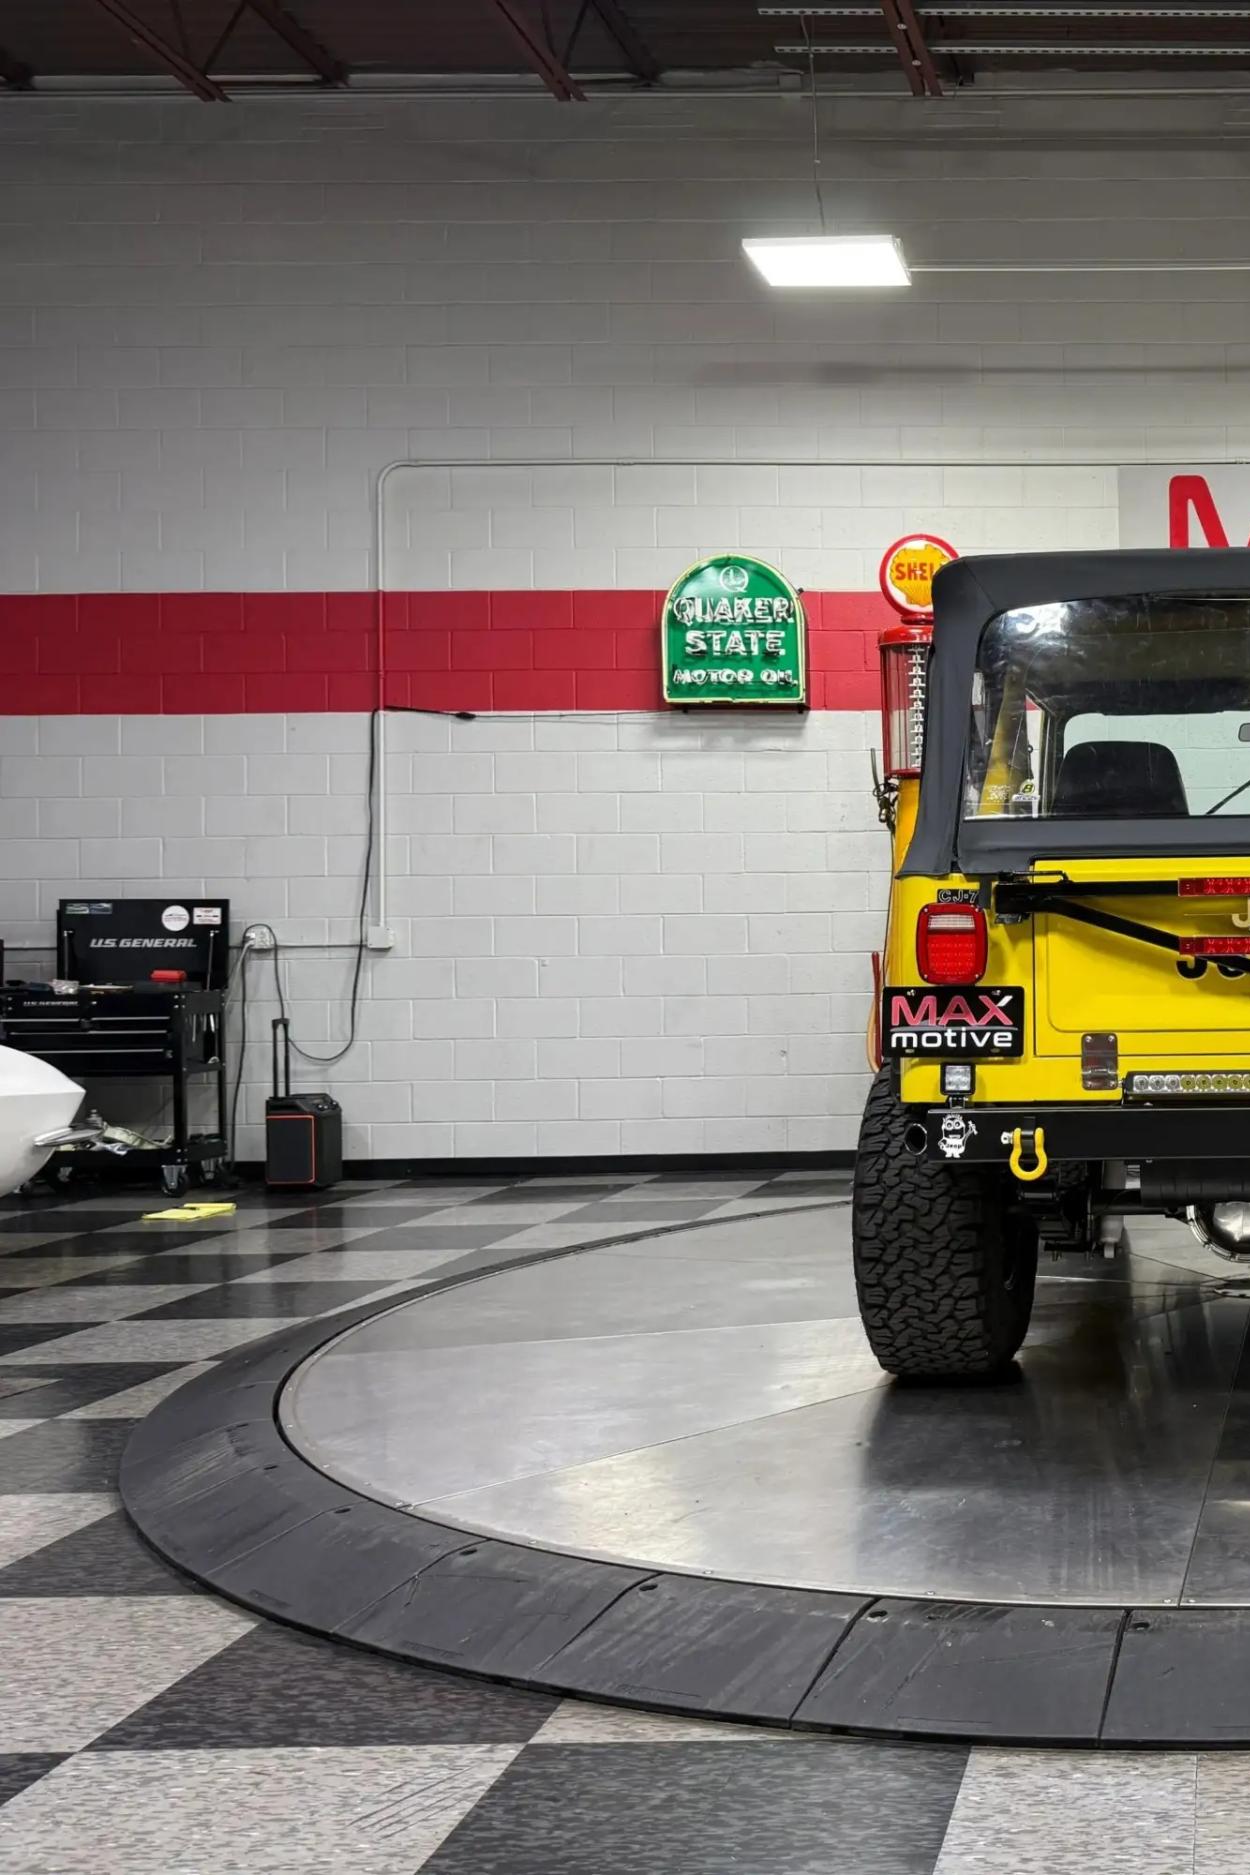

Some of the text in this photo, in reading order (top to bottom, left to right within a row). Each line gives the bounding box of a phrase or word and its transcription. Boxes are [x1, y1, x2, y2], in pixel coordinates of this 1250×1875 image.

[895, 562, 934, 581] SHEL
[673, 597, 795, 625] QUAKER
[685, 630, 786, 656] STATE
[672, 668, 754, 686] MOTOR
[119, 938, 198, 948] GENERAL
[891, 995, 1013, 1026] MAX
[891, 1026, 1013, 1048] motive
